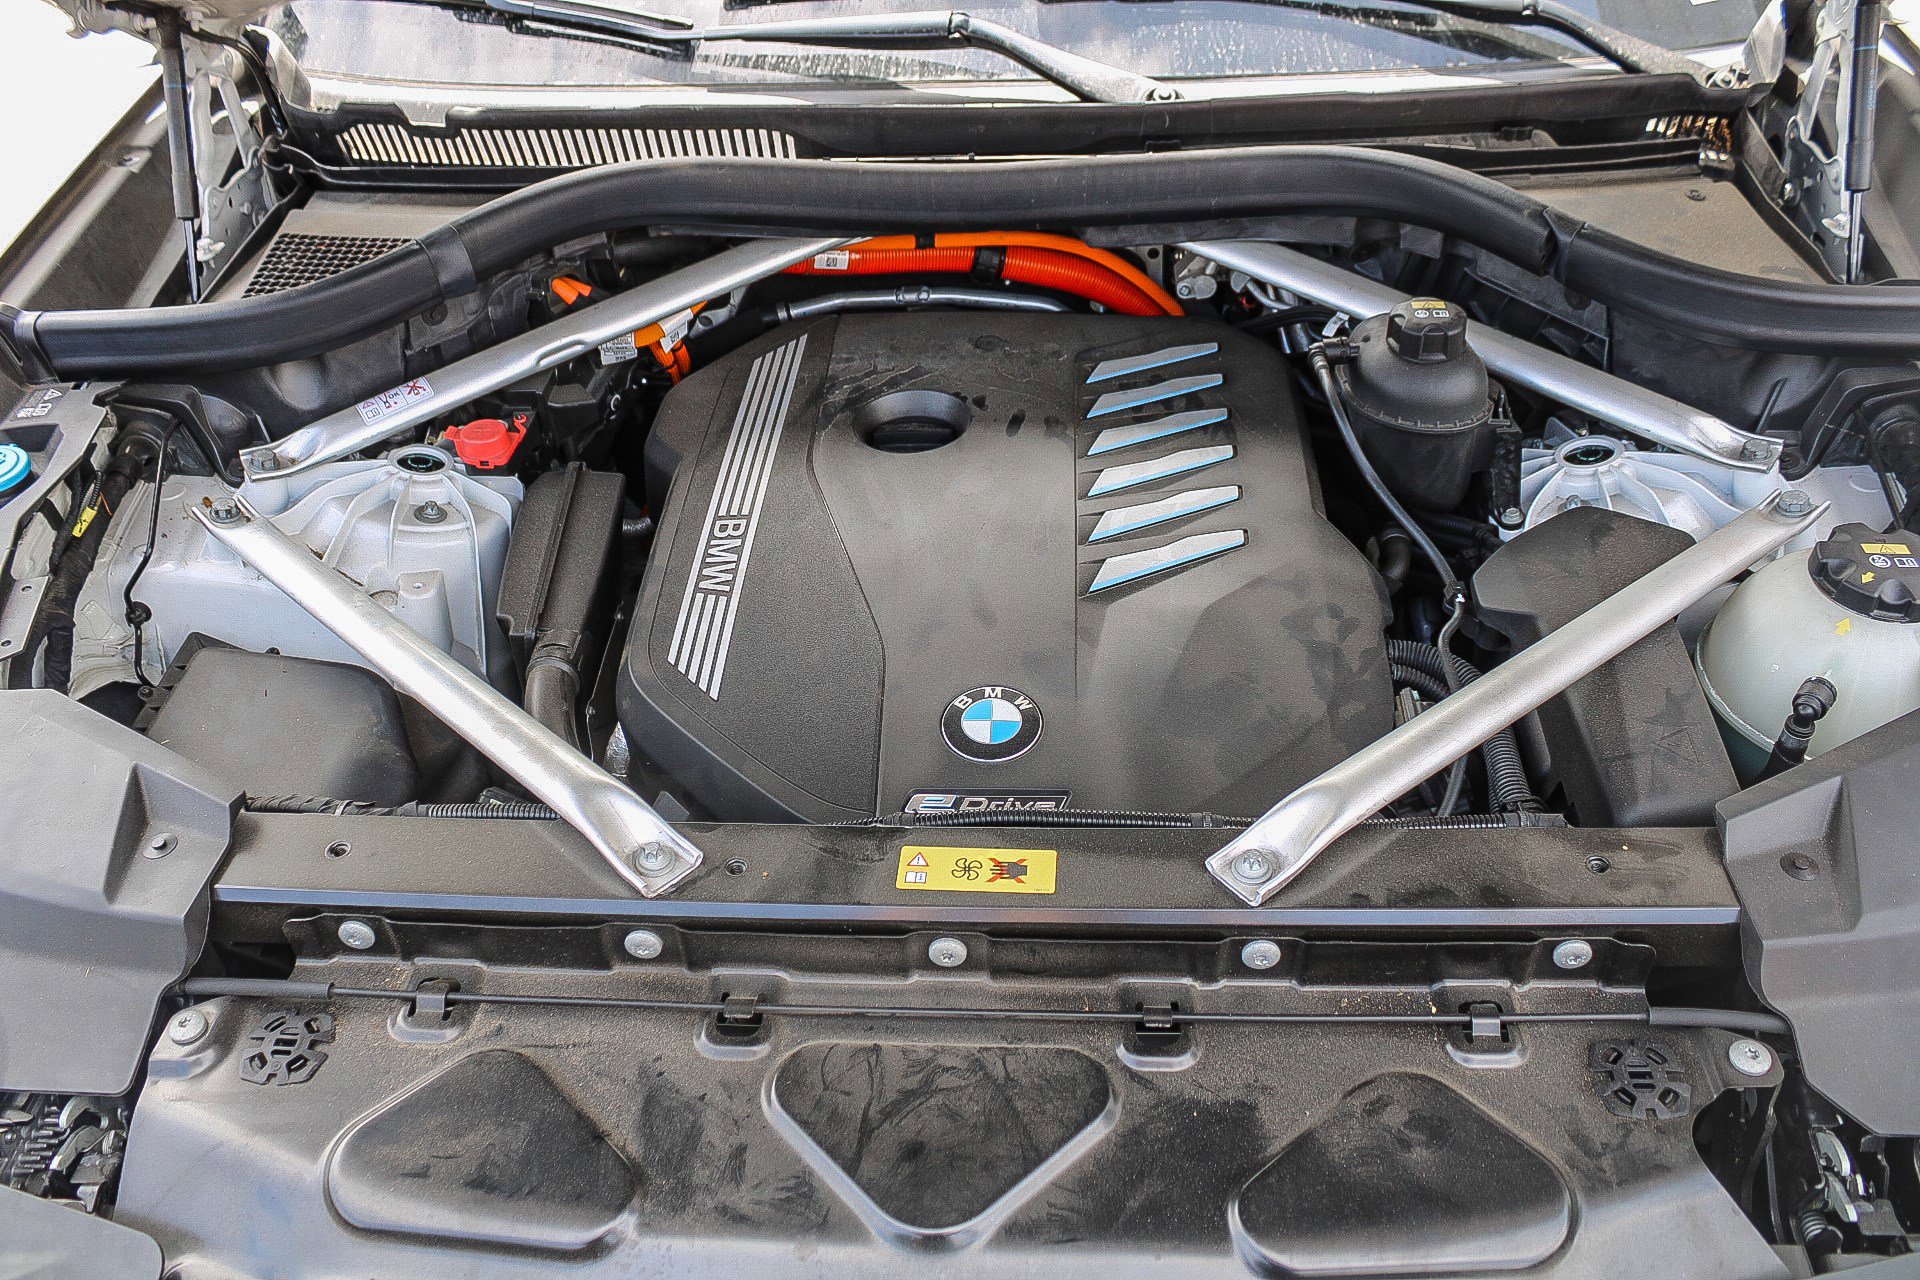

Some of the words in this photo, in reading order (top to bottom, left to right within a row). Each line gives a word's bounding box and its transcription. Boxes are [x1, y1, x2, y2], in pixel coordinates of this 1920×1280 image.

[388, 391, 400, 400] OK
[699, 519, 748, 592] BMW
[954, 687, 1034, 711] BMW
